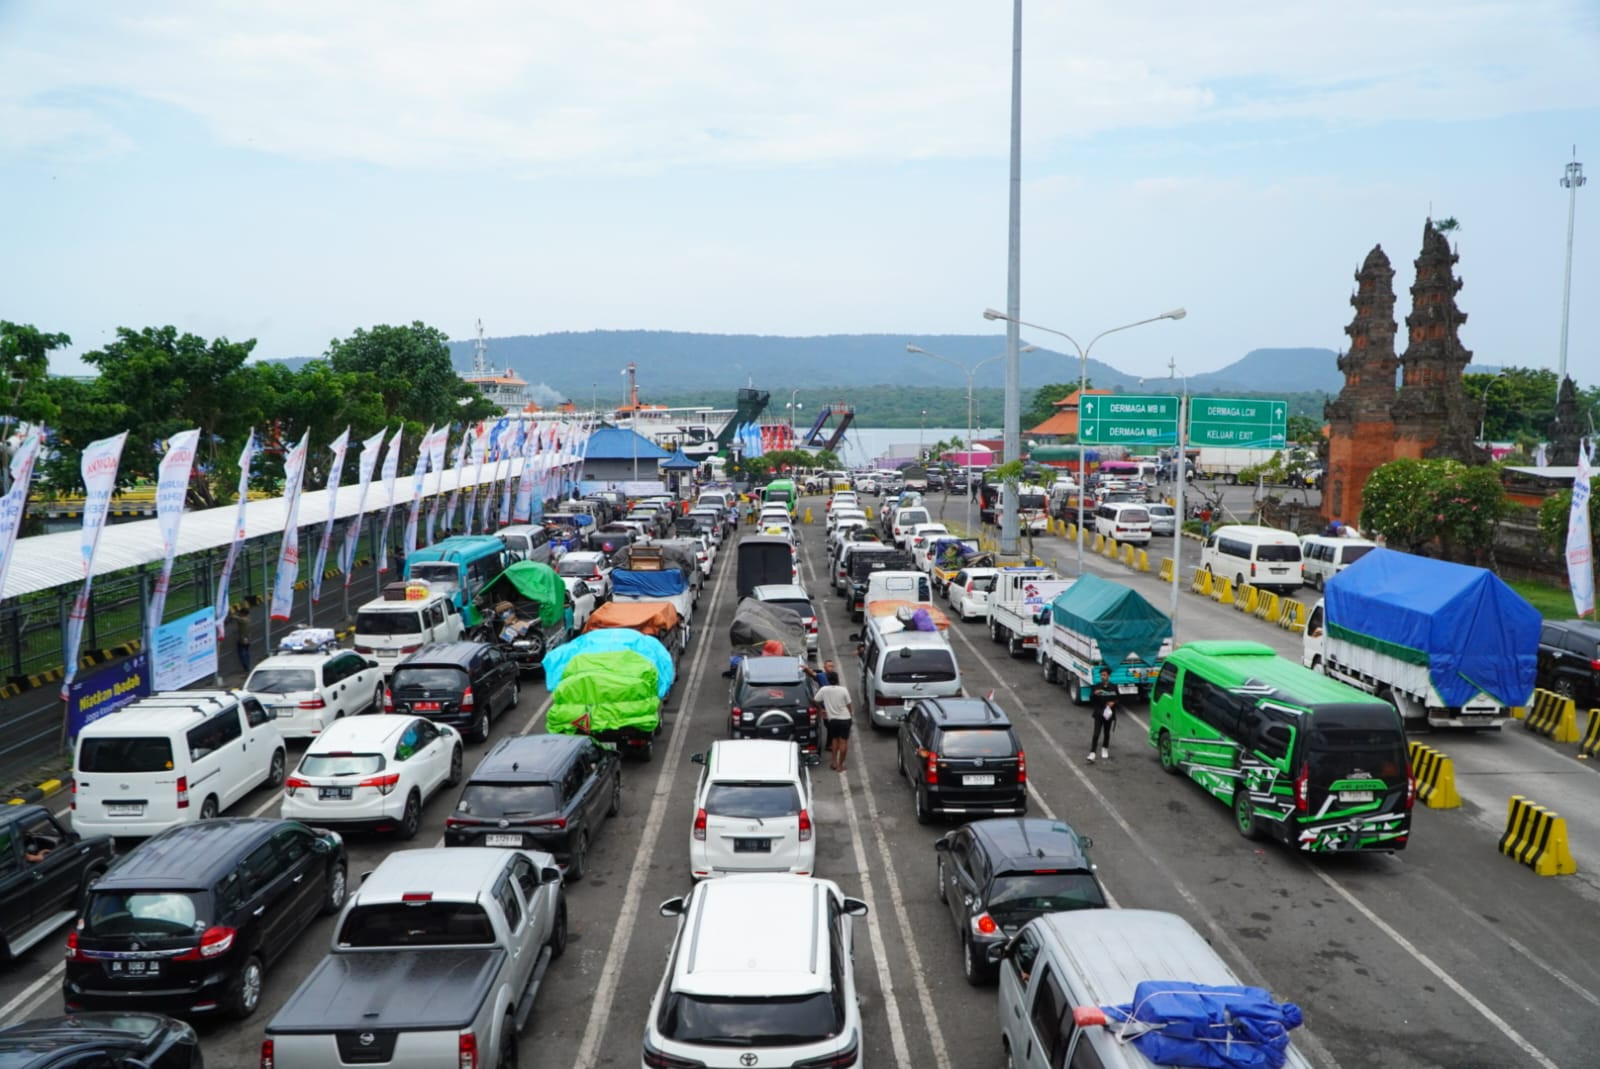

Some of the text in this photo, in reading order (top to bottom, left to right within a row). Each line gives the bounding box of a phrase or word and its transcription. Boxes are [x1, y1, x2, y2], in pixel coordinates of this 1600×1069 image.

[1110, 404, 1146, 413] DERMAGA
[1147, 404, 1158, 414] MB
[1208, 406, 1256, 417] DERMAGA LCM
[1109, 427, 1145, 437] DERMAGA
[1207, 430, 1234, 440] KELUAR
[1239, 431, 1254, 441] EXIT
[113, 673, 141, 696] Ibadah
